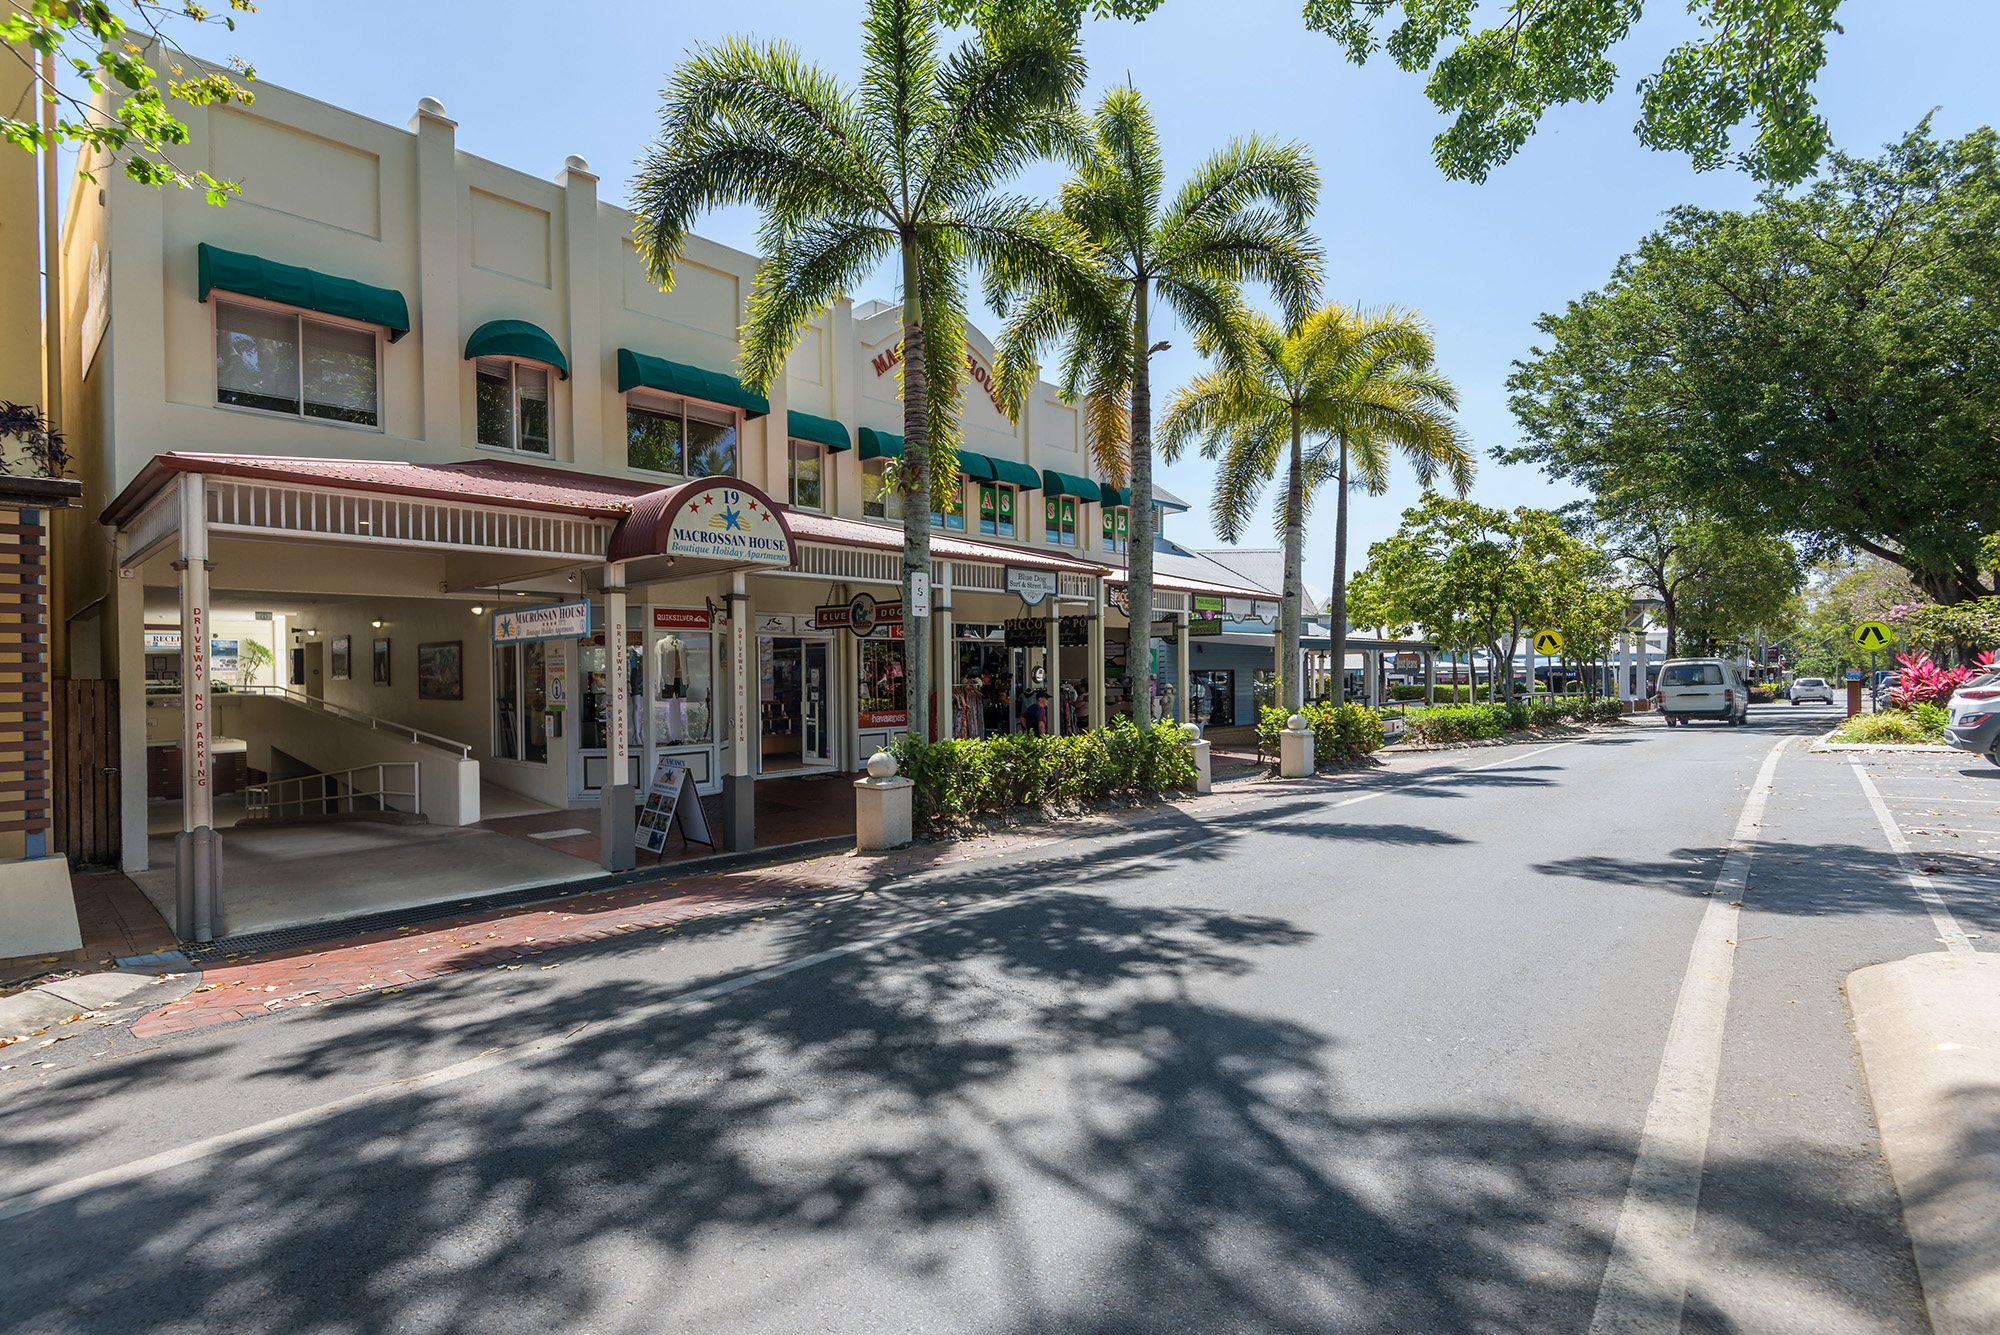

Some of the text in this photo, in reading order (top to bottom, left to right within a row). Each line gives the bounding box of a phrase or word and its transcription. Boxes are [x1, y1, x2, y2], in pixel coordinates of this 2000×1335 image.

[723, 489, 740, 505] 19
[672, 528, 786, 552] MACROSSAN HOUSE
[671, 541, 788, 561] Boutique Holiday Apartments
[1018, 573, 1047, 585] Blue Dog
[515, 604, 586, 625] MACROSSAN HOUSE
[656, 613, 694, 622] QUIKSILVER
[823, 607, 903, 621] BLUE DOG
[1006, 619, 1047, 631] PICCO
[1073, 619, 1088, 628] PO
[193, 607, 206, 787] DRIVEWAY NO PARKING
[617, 687, 623, 700] NO
[738, 685, 744, 697] NO
